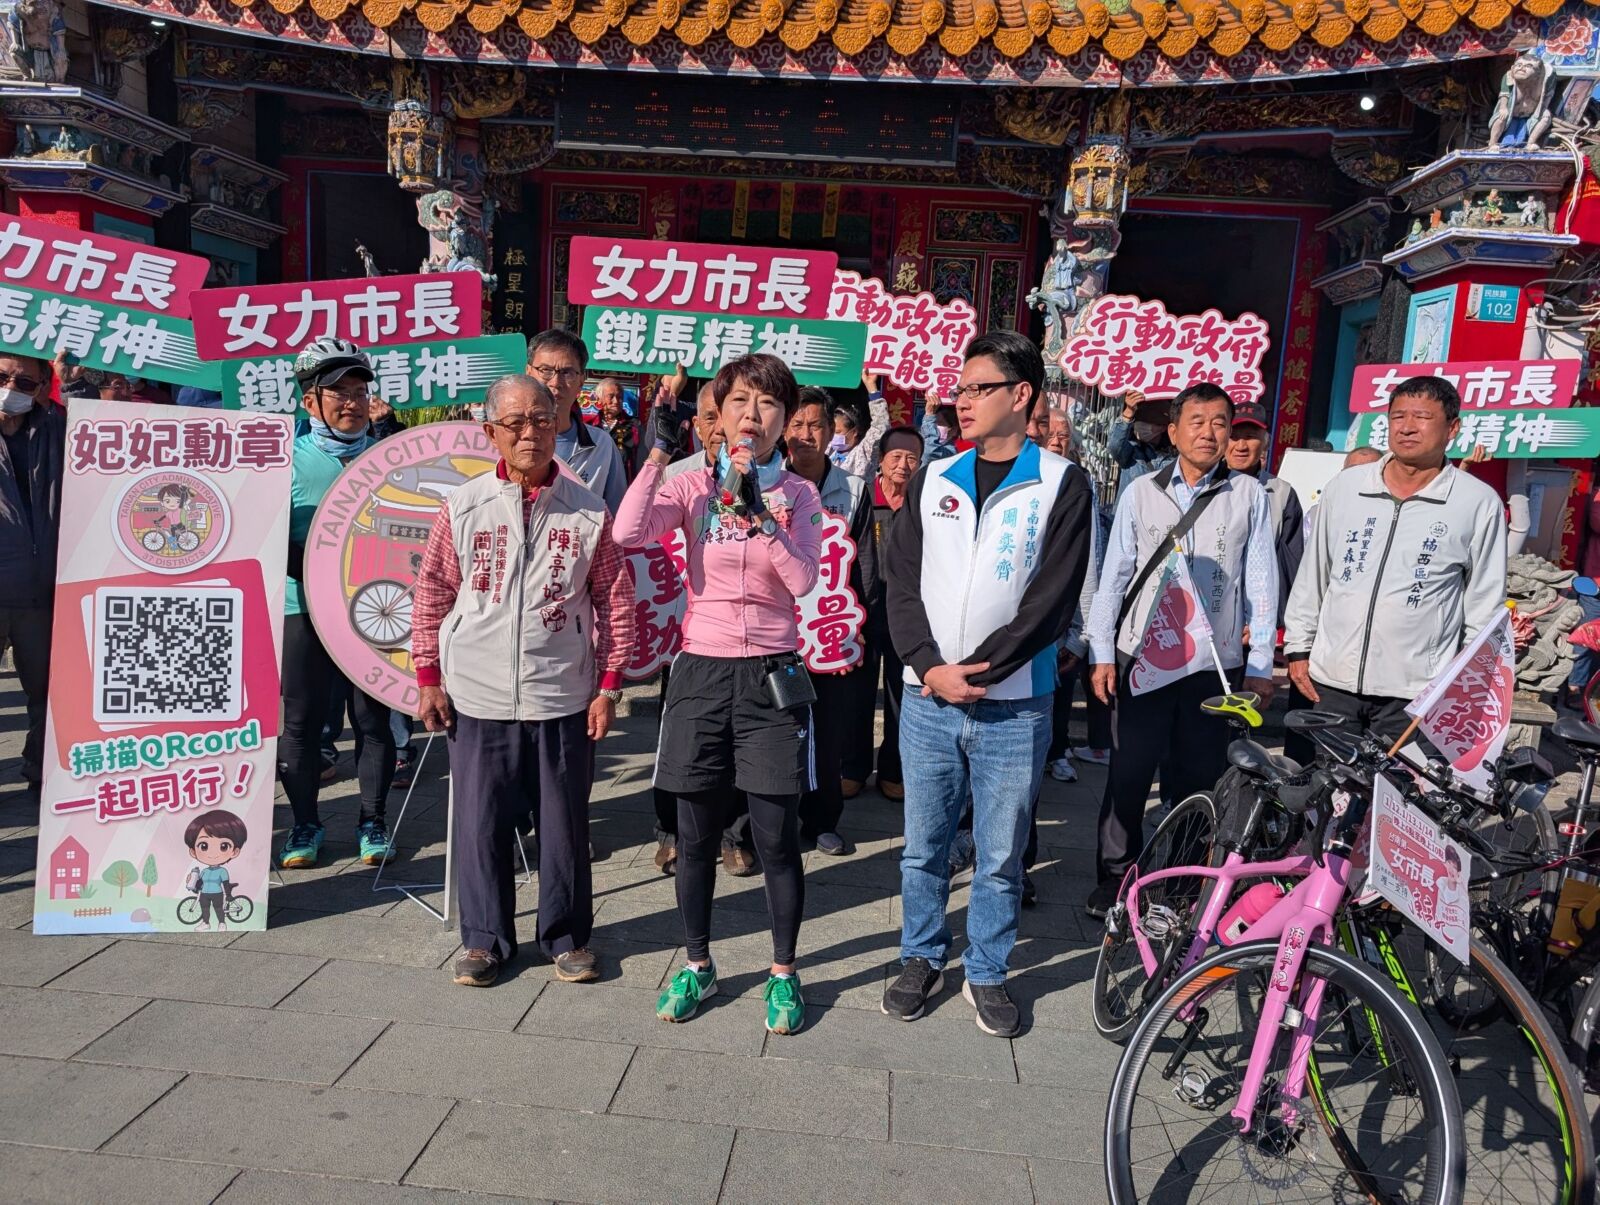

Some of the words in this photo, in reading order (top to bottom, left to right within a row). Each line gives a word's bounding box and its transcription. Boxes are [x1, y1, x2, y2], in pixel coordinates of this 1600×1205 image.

[591, 244, 812, 314] 女力市長
[1486, 302, 1512, 315] 102
[218, 280, 461, 353] 女力市長
[593, 310, 809, 372] 鐵馬精神
[1091, 301, 1263, 369] 行動政府
[236, 345, 468, 413] 鐵精神
[73, 421, 287, 471] 妃妃勳章
[120, 488, 141, 519] TAINAN
[139, 476, 160, 490] CITY
[161, 474, 222, 519] ADMINISTRATIVE
[316, 460, 383, 550] TAINAN
[384, 431, 443, 466] CITY
[142, 553, 154, 562] 37
[155, 549, 206, 567] DISTRICTS
[472, 531, 492, 593] 簡光輝
[491, 524, 508, 604] 楠西後援會會長
[543, 527, 571, 602] 陳亭妃
[571, 526, 581, 559] 立法委員
[1024, 498, 1040, 569] 台南市議員
[1341, 530, 1359, 582] 江森原
[1211, 523, 1227, 614] 台南市楠西區
[1406, 537, 1438, 609] 楠西區公所
[364, 666, 399, 692] 37
[72, 721, 259, 774] 掃描QRcord
[1390, 848, 1435, 892] 女市長
